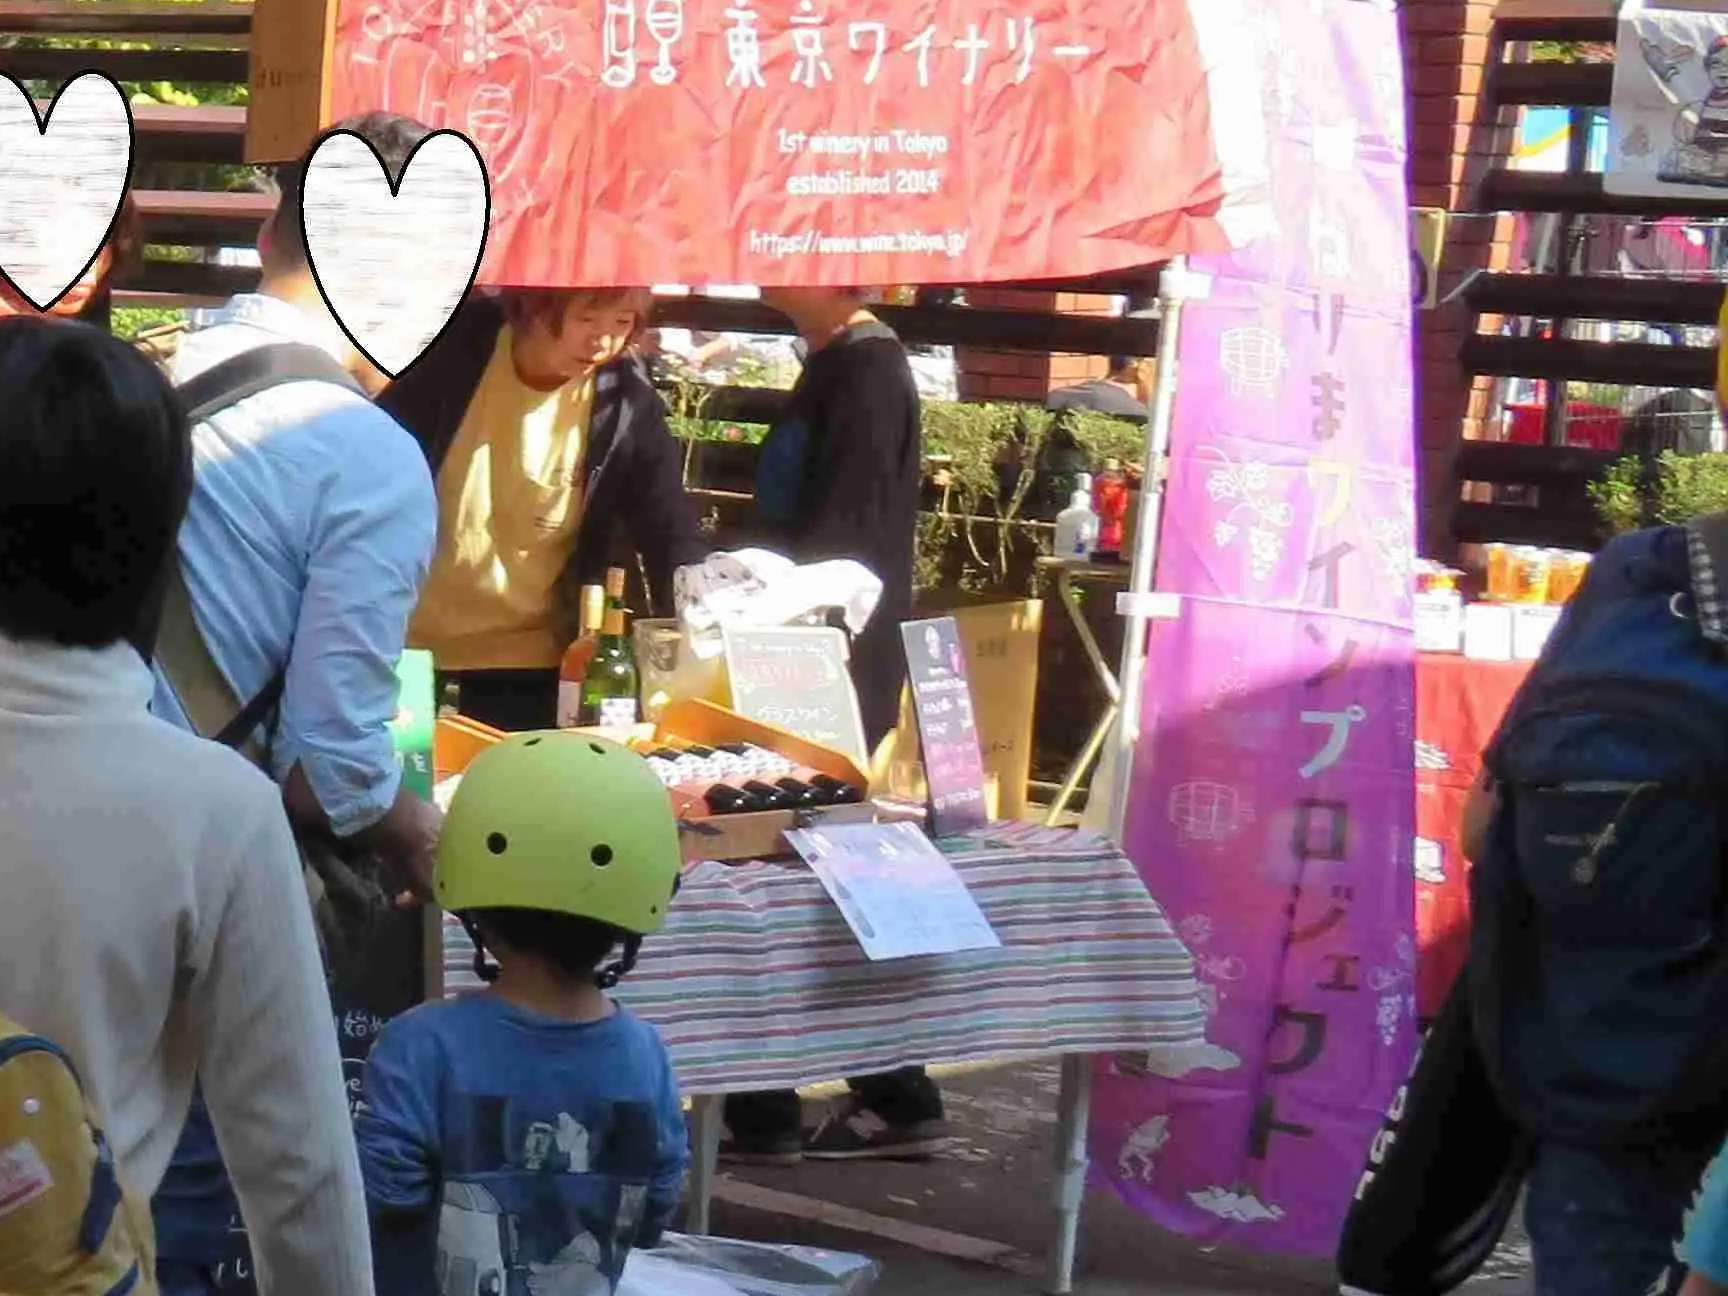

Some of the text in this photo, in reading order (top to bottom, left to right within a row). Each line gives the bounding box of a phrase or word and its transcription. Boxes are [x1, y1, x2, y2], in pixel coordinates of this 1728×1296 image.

[777, 129, 948, 160] 1st winery in Tokyo
[786, 169, 940, 194] established 2014
